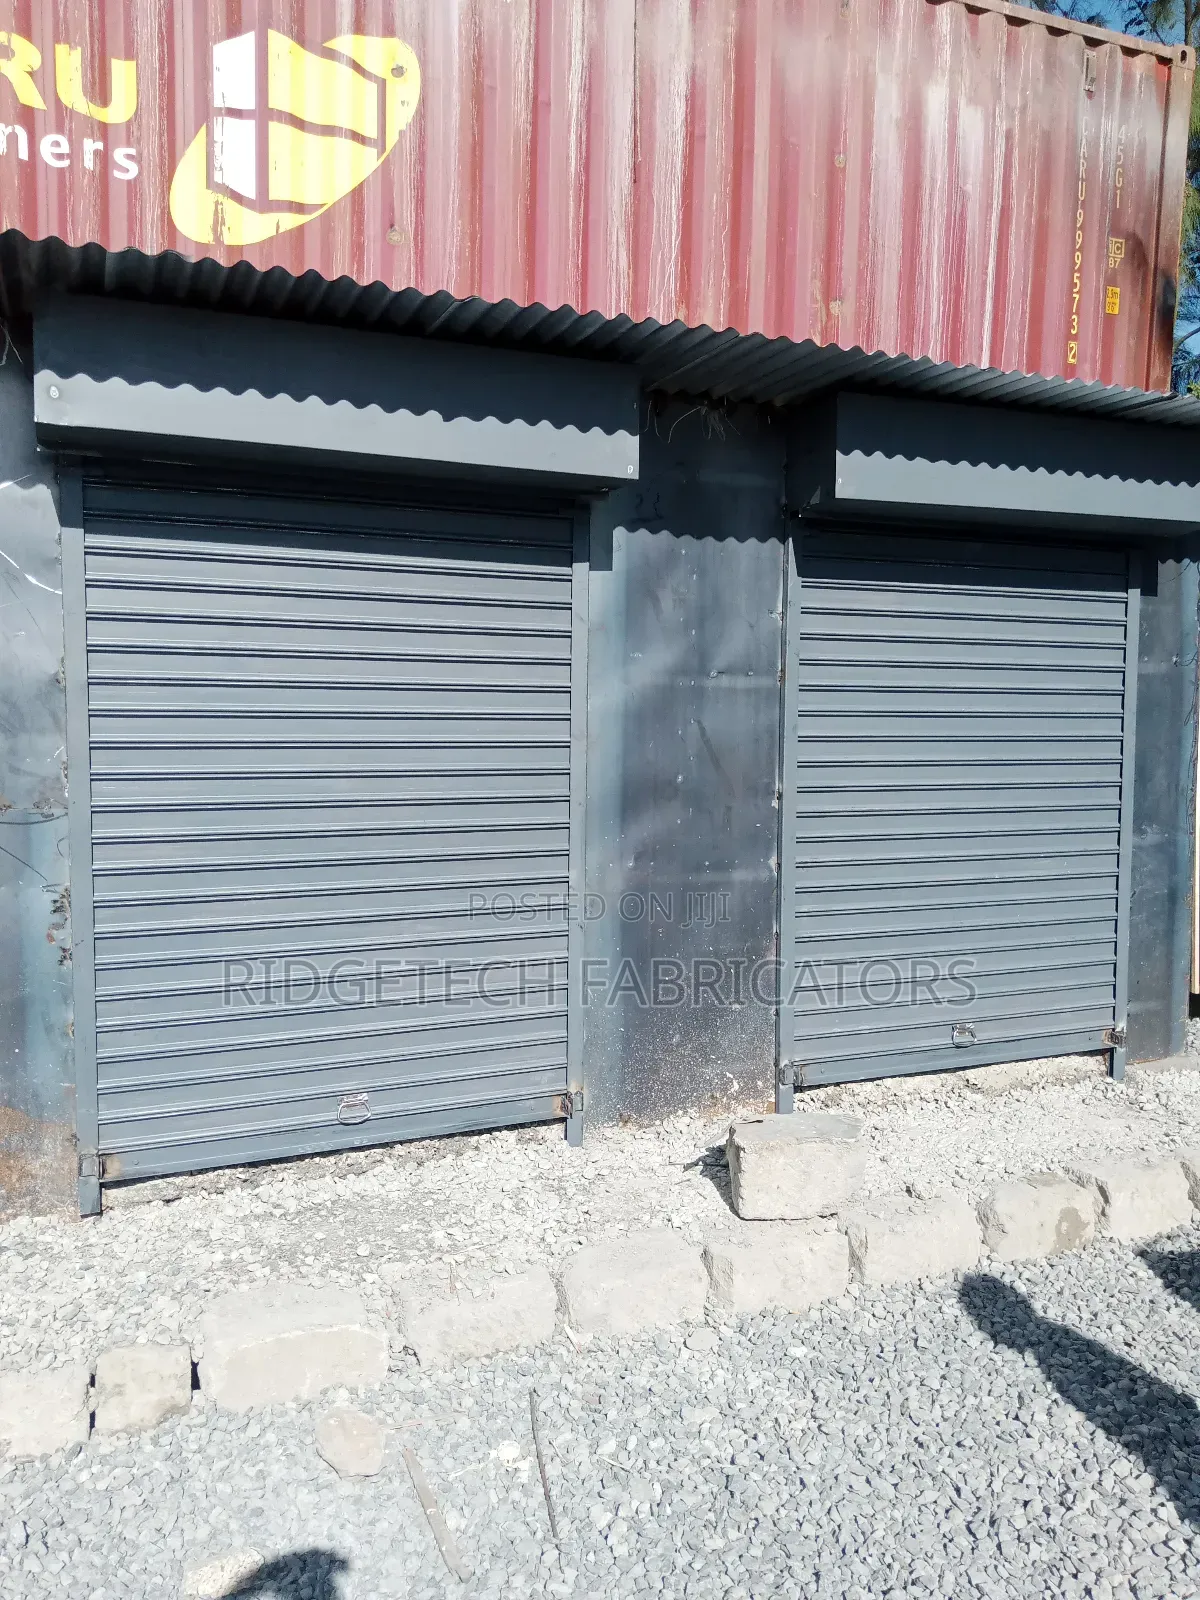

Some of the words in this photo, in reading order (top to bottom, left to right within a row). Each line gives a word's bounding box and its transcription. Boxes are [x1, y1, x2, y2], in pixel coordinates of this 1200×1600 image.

[1115, 124, 1126, 209] 45G1
[1070, 209, 1084, 334] 999573
[1108, 256, 1121, 269] 87
